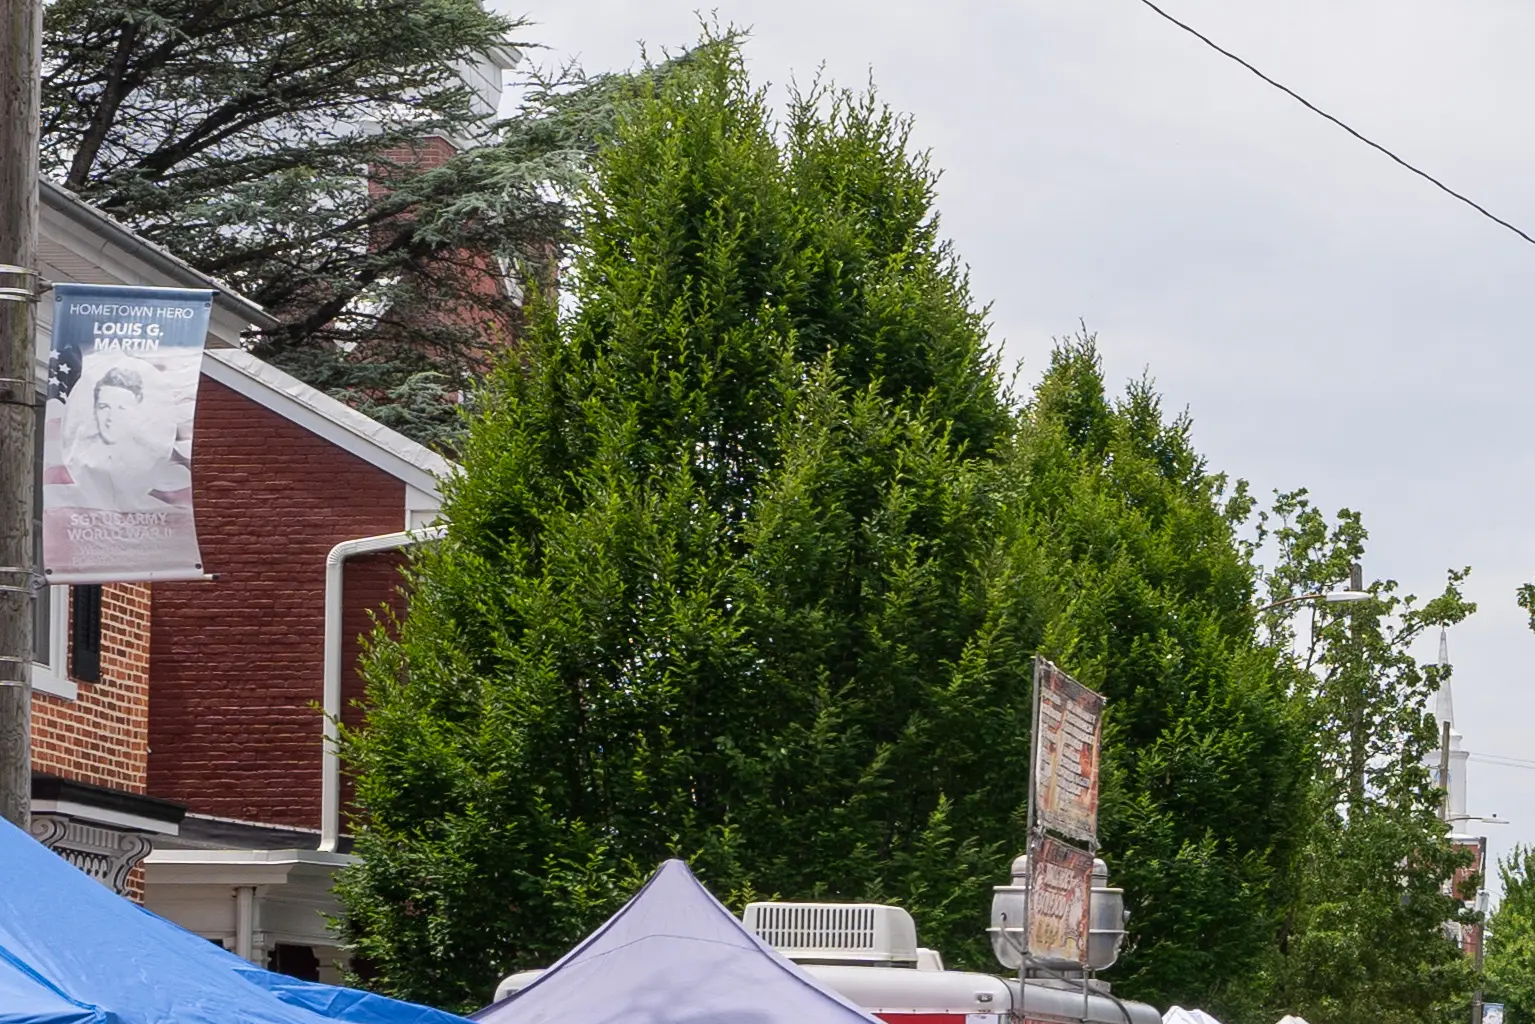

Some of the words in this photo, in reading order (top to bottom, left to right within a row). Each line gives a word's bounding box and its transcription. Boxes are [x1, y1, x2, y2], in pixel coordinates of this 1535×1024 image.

[69, 303, 153, 317] HOMETOWN
[156, 307, 194, 319] HERO
[93, 321, 142, 336] LOUIS
[146, 323, 164, 337] G.
[94, 337, 159, 351] MARTIN
[70, 513, 98, 526] SGT
[123, 511, 168, 525] ARMY
[67, 528, 121, 541] WORLD
